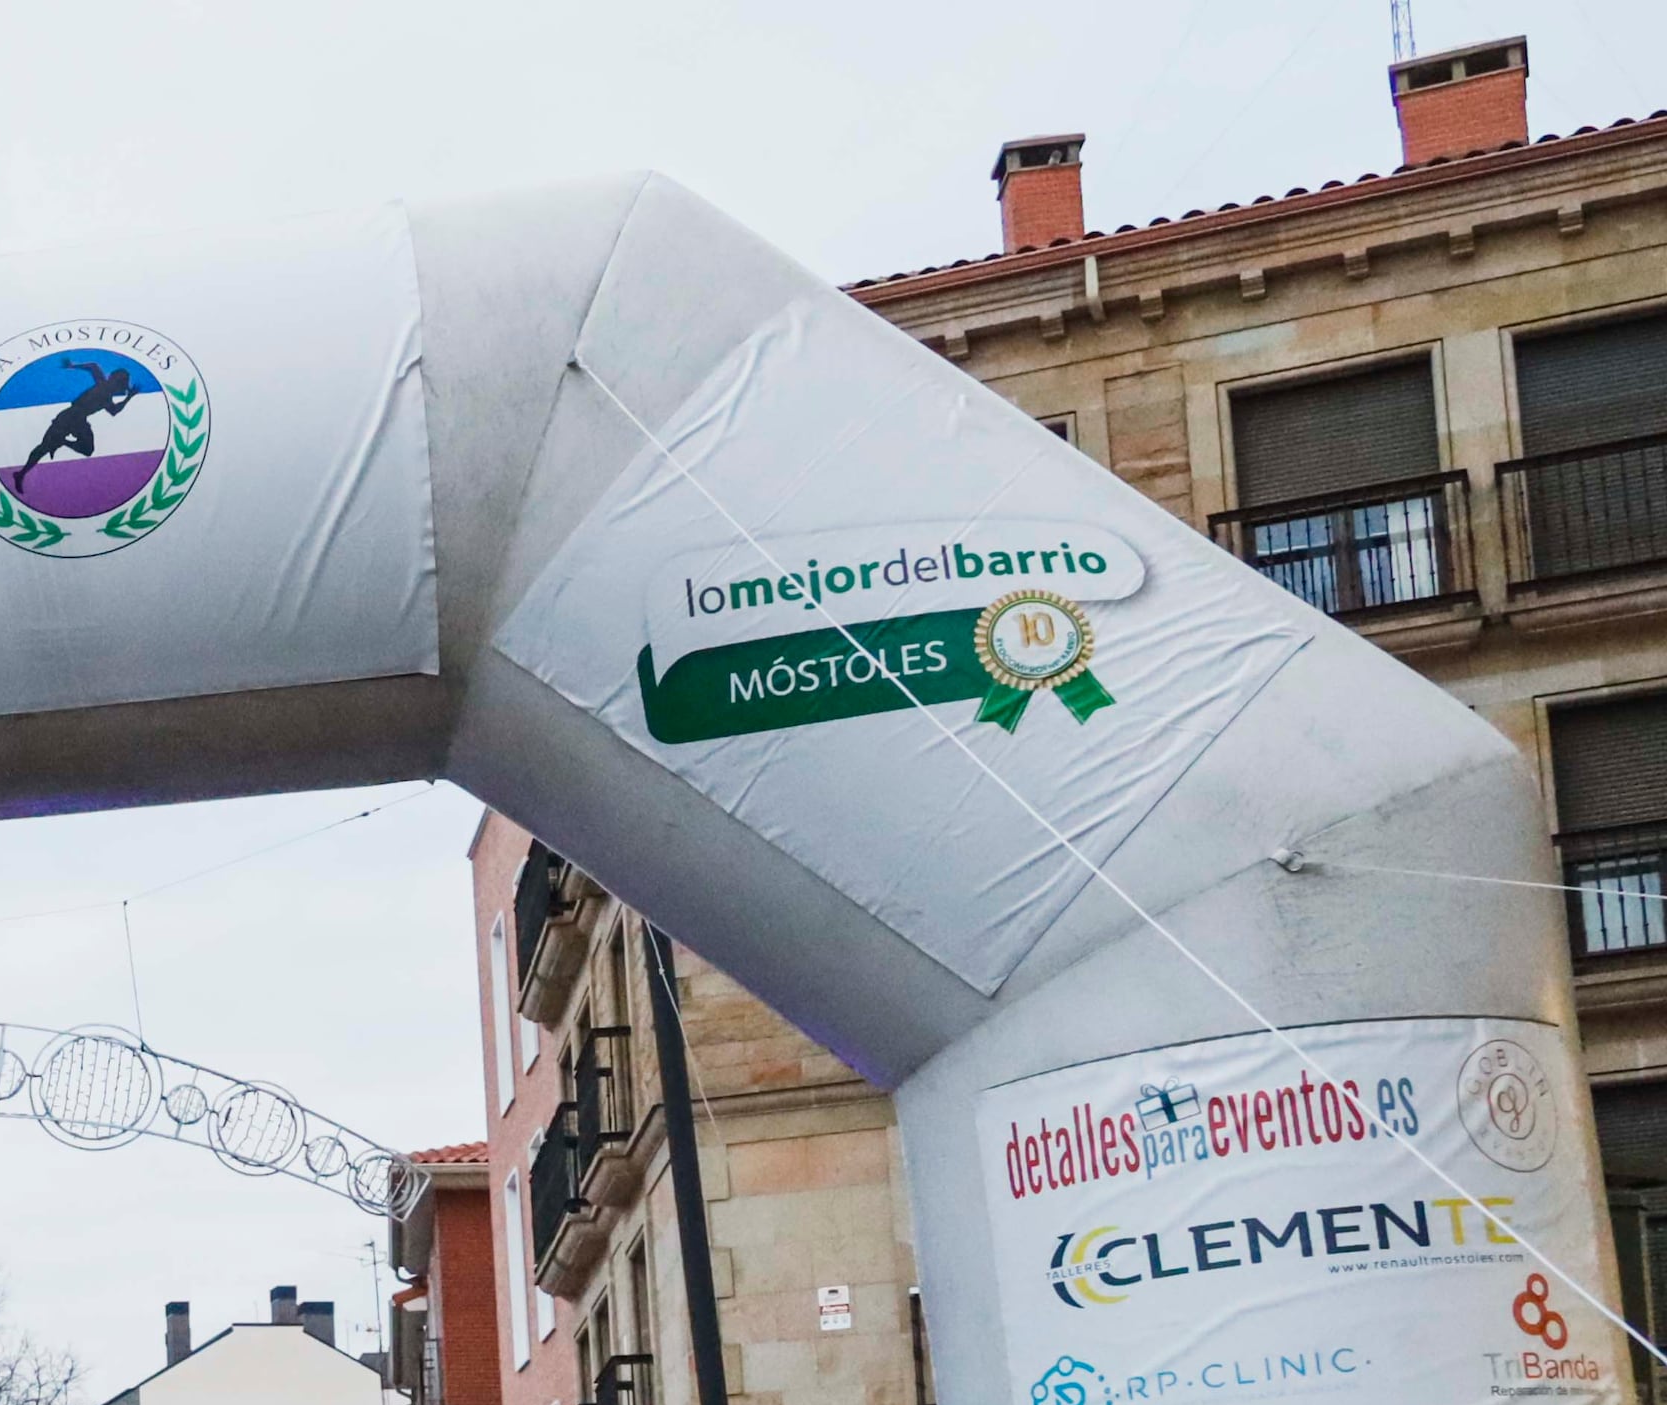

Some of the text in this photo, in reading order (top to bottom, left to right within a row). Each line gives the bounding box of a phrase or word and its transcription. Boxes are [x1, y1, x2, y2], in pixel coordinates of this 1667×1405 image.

[28, 326, 179, 371] MOSTOLES
[1016, 611, 1055, 649] 10
[729, 640, 948, 704] MÓSTOLES
[1097, 1198, 1519, 1287] CLEMENTE
[1045, 1260, 1111, 1281] TALLERES
[1484, 1352, 1600, 1381] TriBanda
